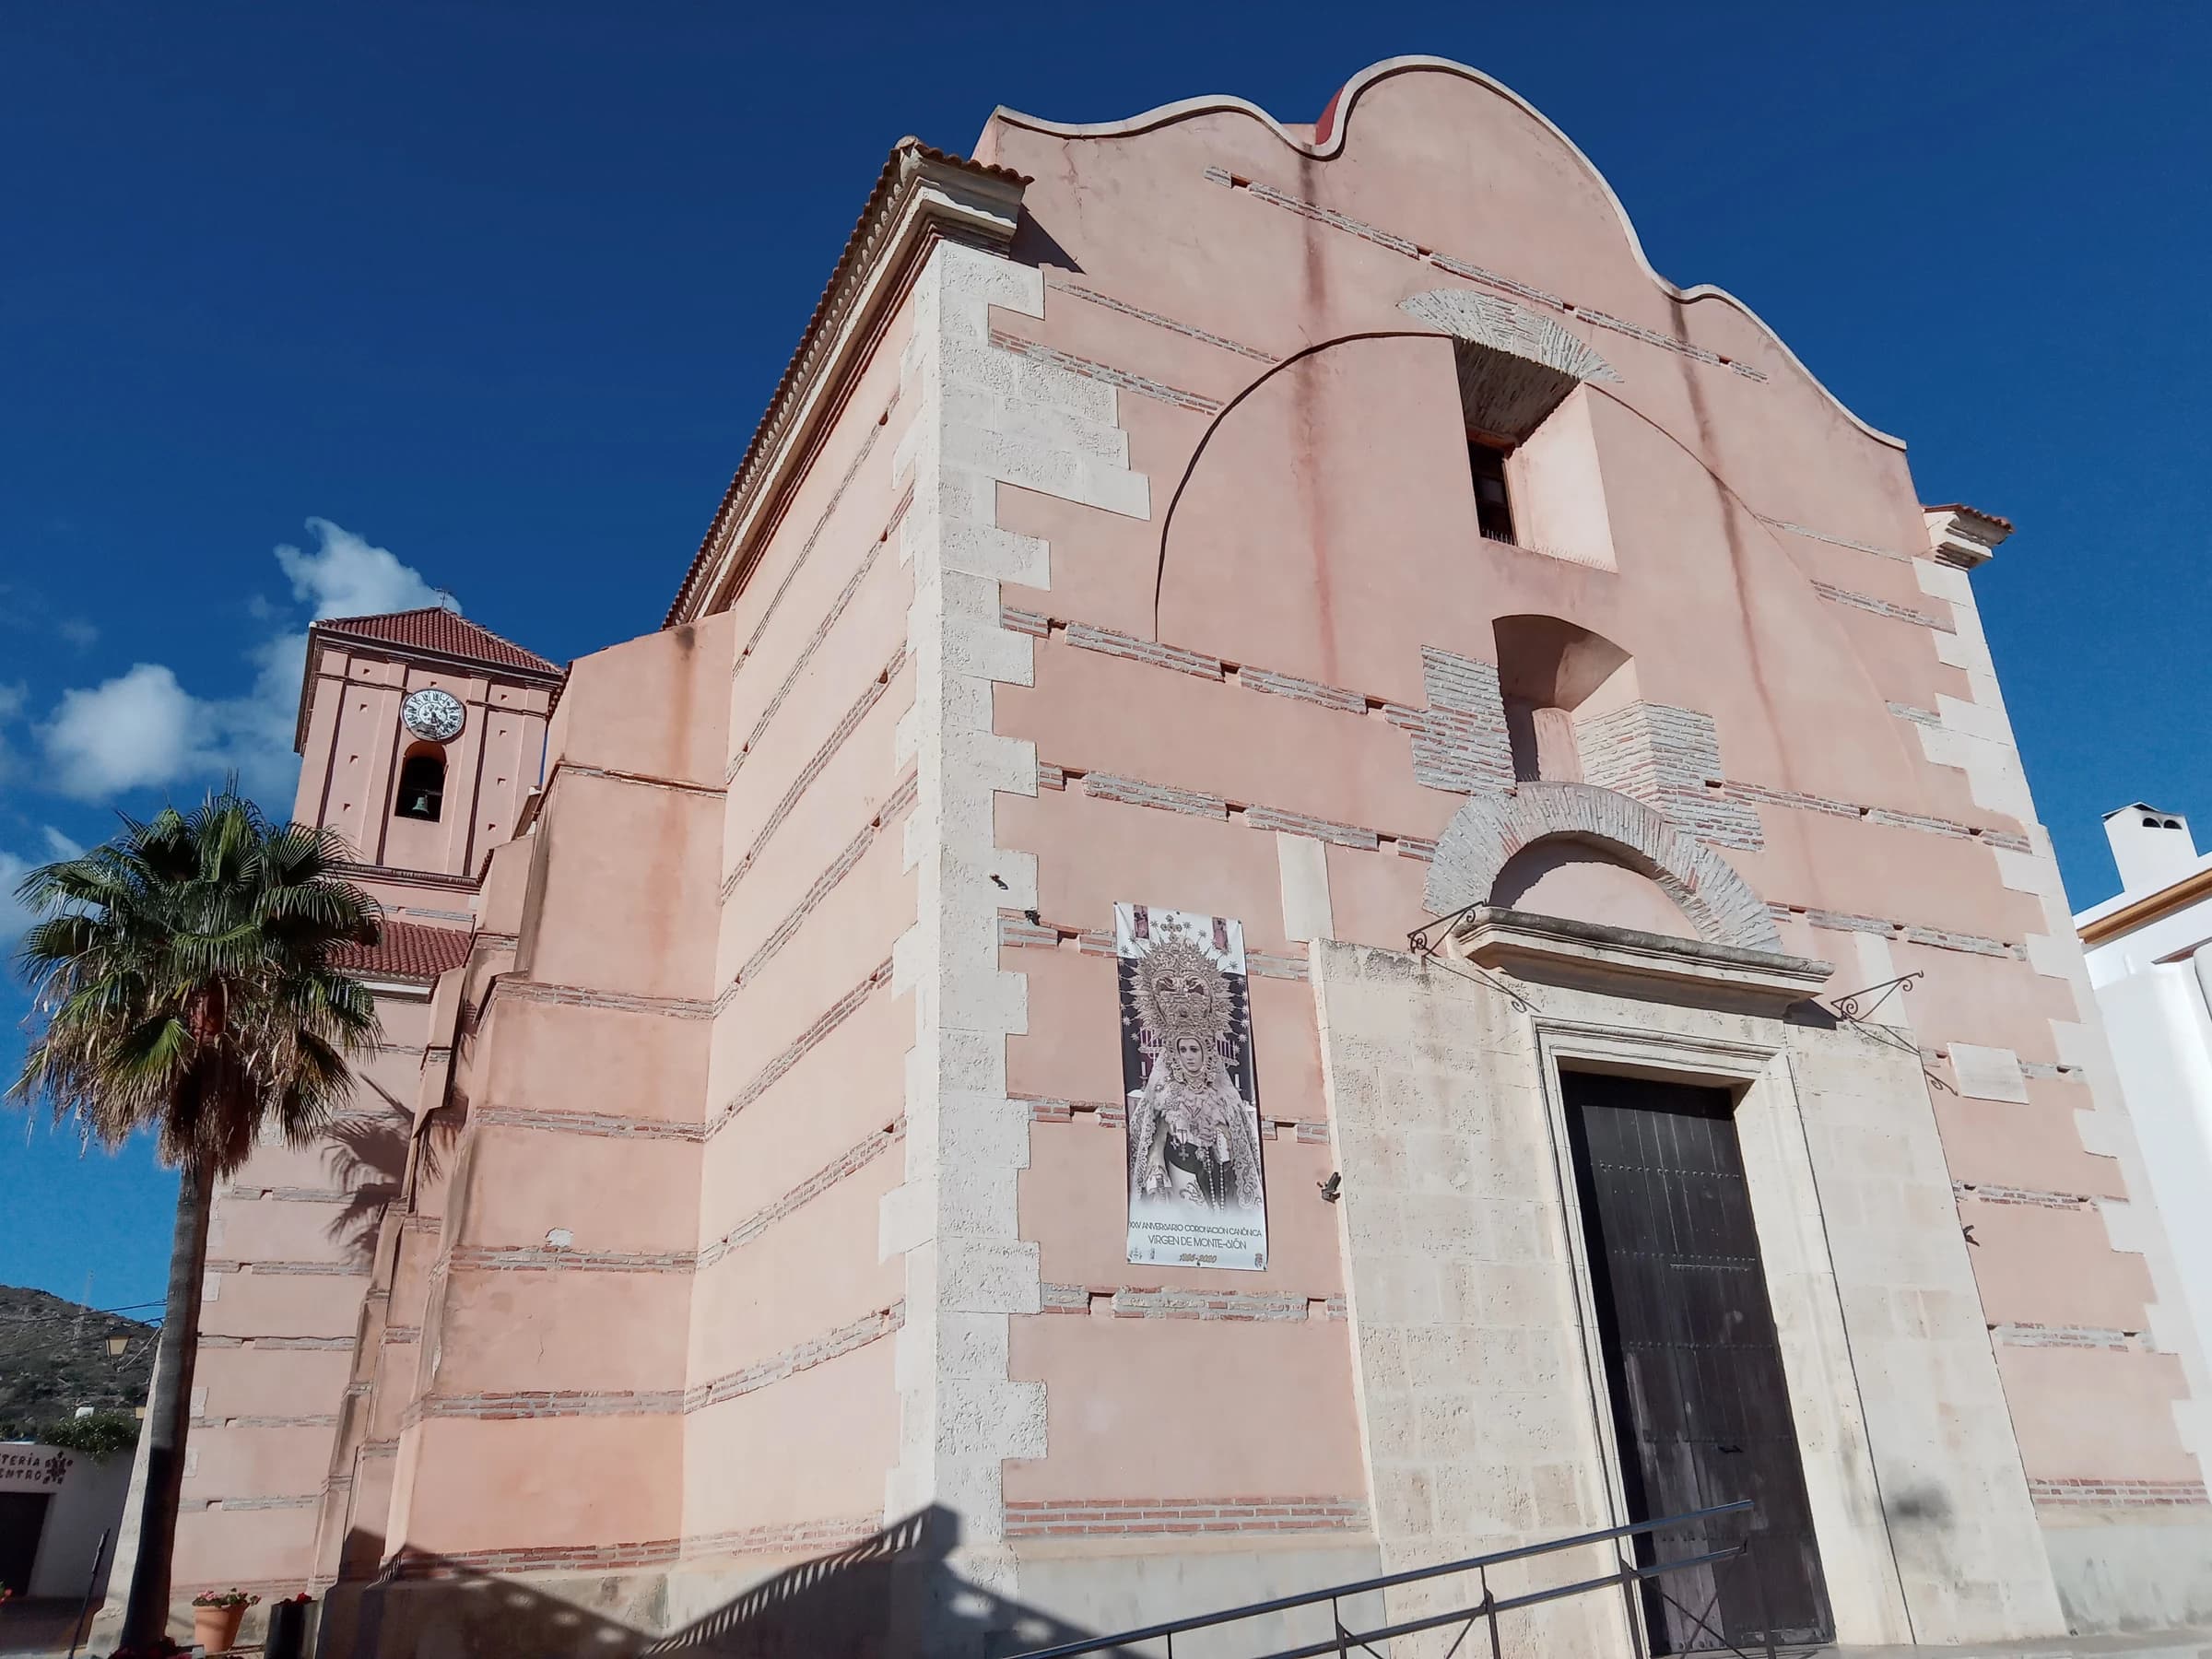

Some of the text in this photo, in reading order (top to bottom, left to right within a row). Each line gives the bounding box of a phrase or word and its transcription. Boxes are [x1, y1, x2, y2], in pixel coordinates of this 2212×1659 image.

[1129, 1221, 1142, 1230] XXV
[1142, 1222, 1183, 1231] ANIVERSARIO
[1229, 1227, 1262, 1237] CANÓNICA
[1148, 1235, 1180, 1245] VIRGEN
[1181, 1236, 1193, 1246] DE
[0, 1453, 40, 1466] TERÍA
